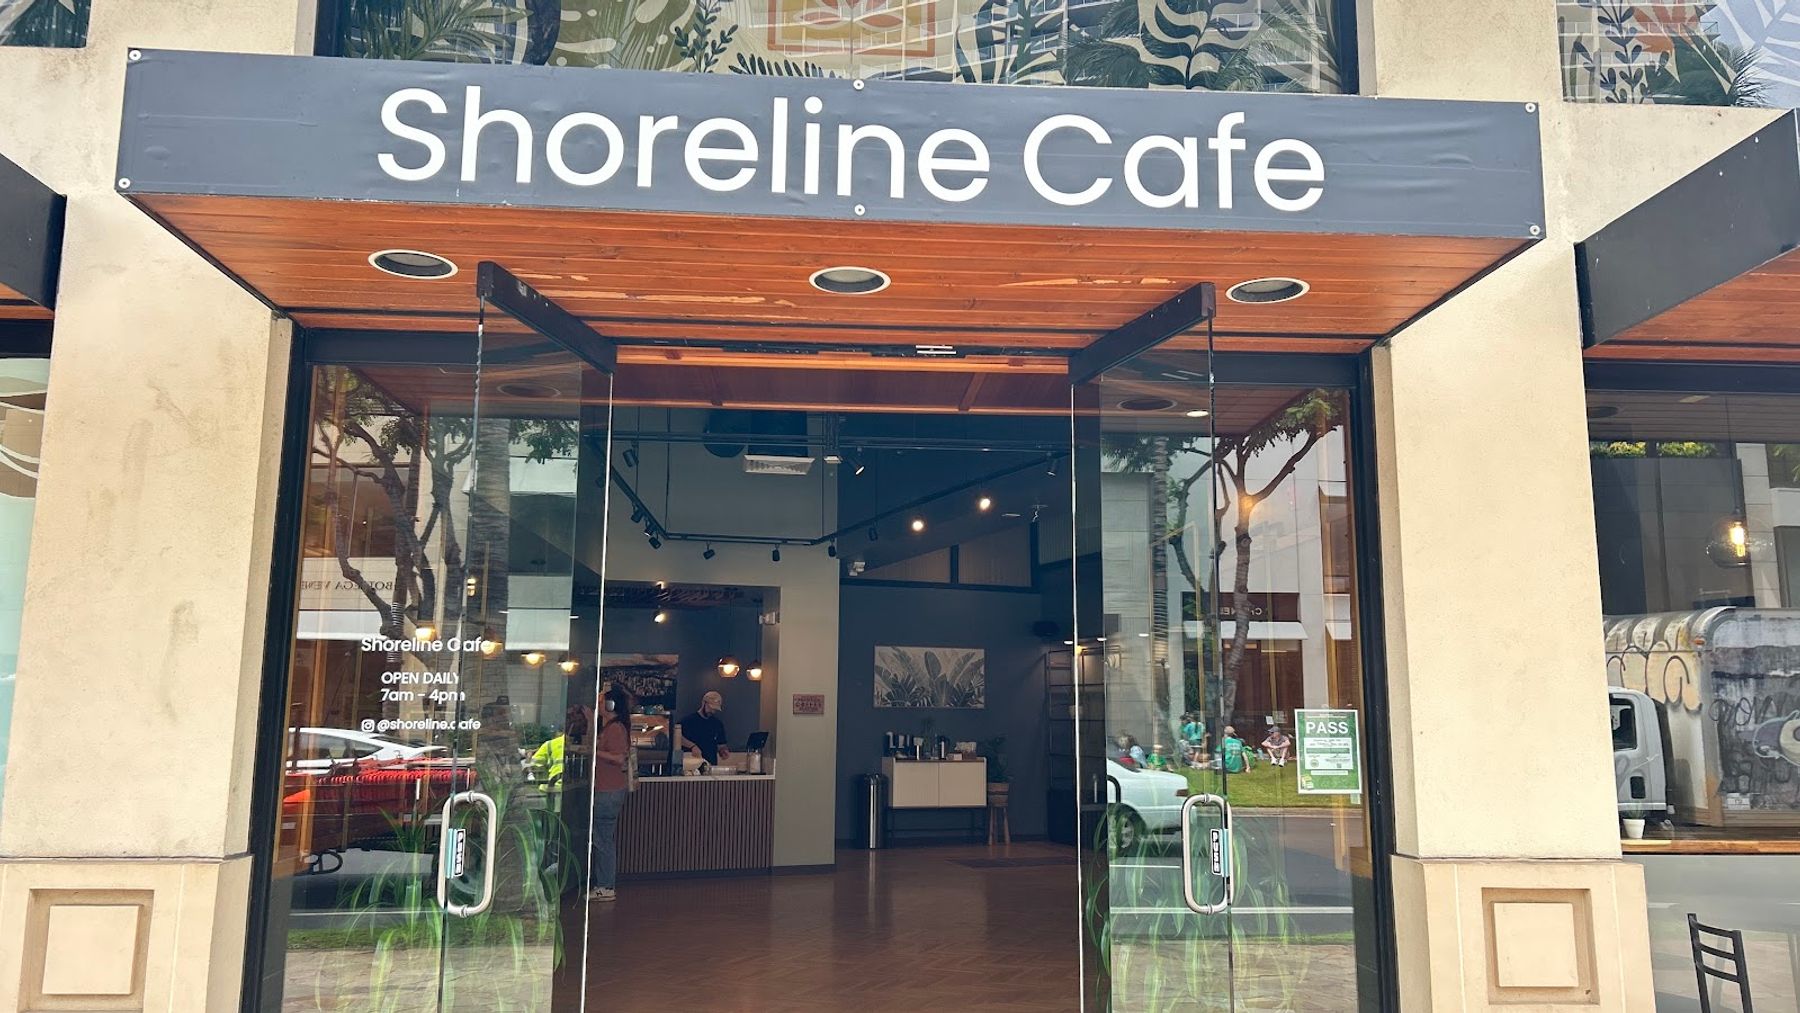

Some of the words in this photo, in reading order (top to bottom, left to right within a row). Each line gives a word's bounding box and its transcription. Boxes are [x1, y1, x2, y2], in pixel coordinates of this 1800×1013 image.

[377, 86, 991, 203] Shoreline
[1022, 111, 1327, 214] Cafe
[361, 636, 443, 652] Shoreline
[381, 671, 419, 685] OPEN
[423, 671, 460, 685] DAILY
[380, 688, 414, 702] 7am
[428, 688, 466, 705] 4pm
[377, 718, 482, 733] @shoreline.cafe
[1305, 721, 1349, 734] PASS
[1212, 831, 1220, 873] PUSH
